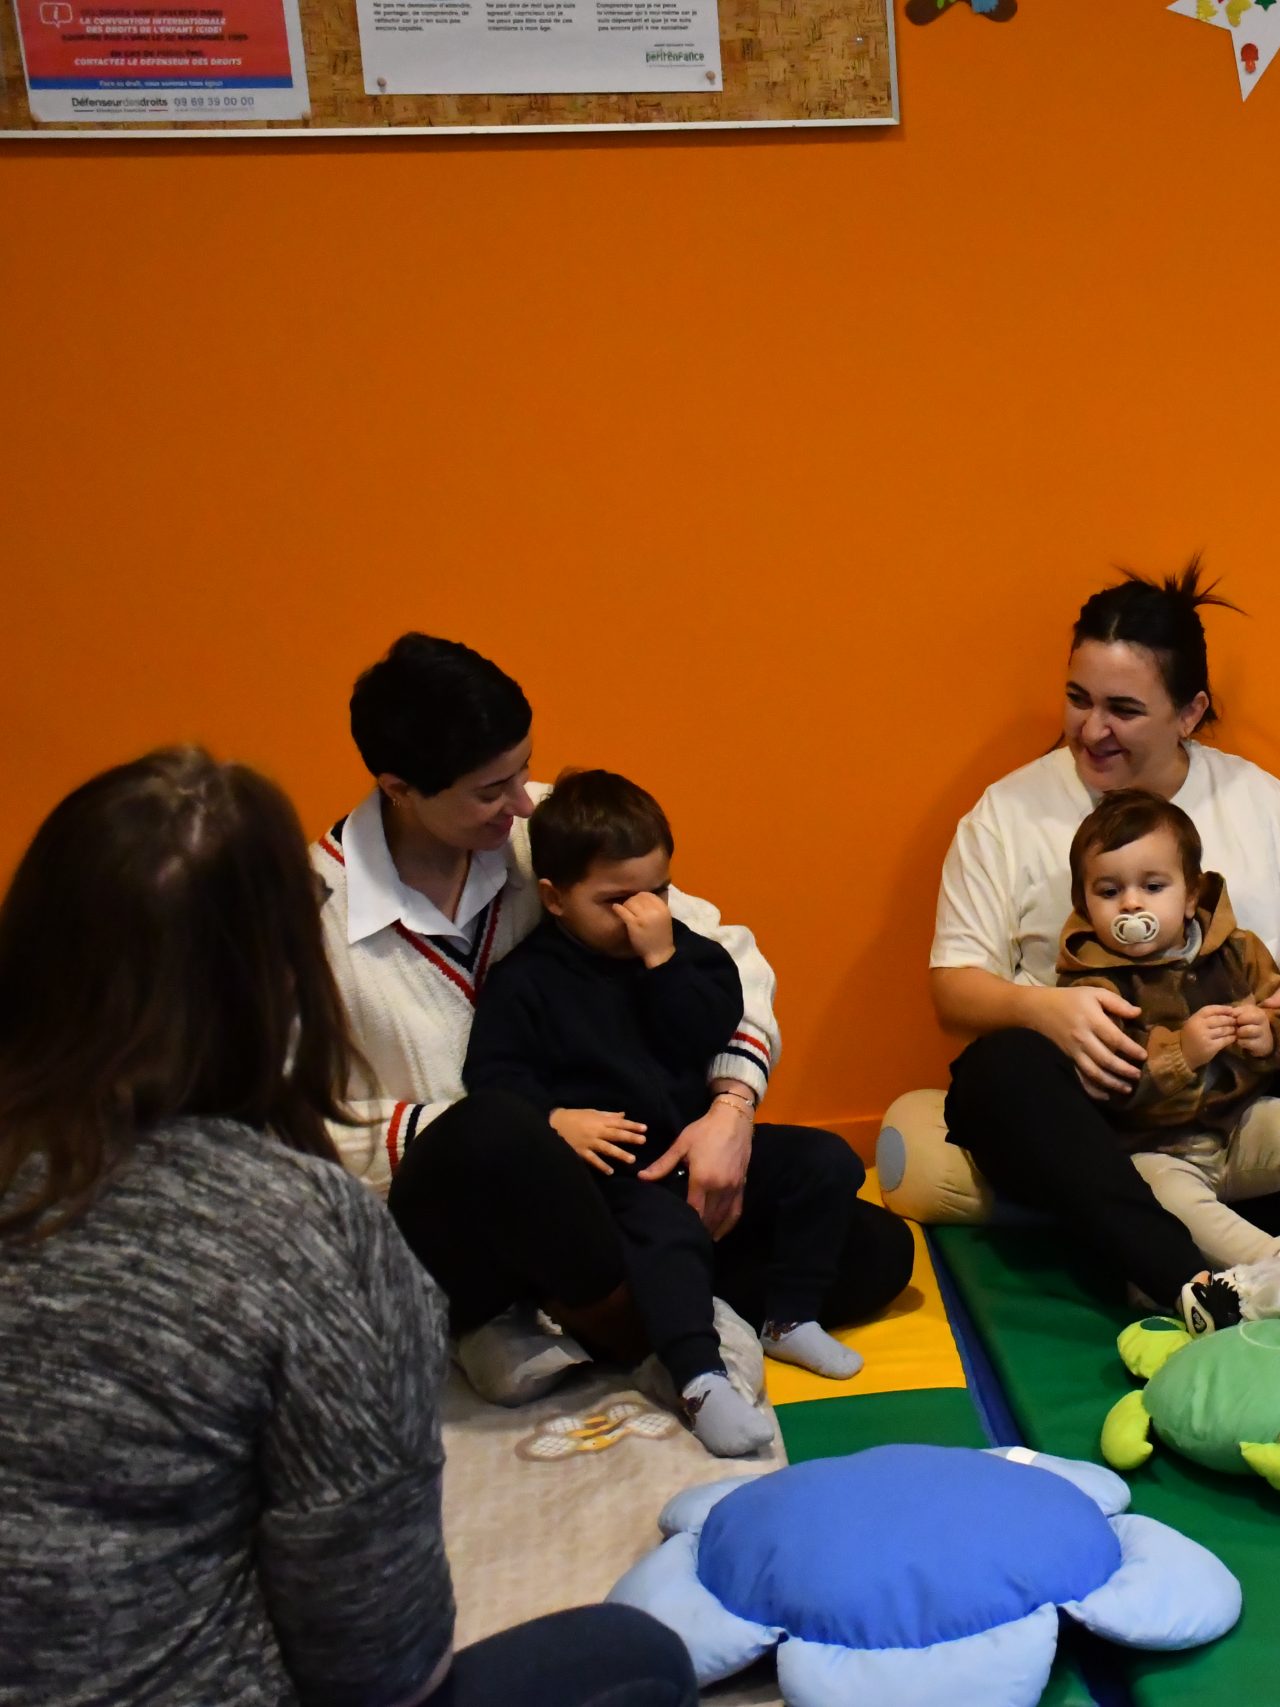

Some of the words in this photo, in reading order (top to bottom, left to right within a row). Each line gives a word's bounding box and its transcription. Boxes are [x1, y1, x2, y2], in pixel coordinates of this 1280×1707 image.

[174, 97, 187, 106] 09
[190, 97, 204, 106] 69
[208, 97, 221, 106] 39
[223, 96, 238, 106] 00
[240, 96, 255, 106] 00
